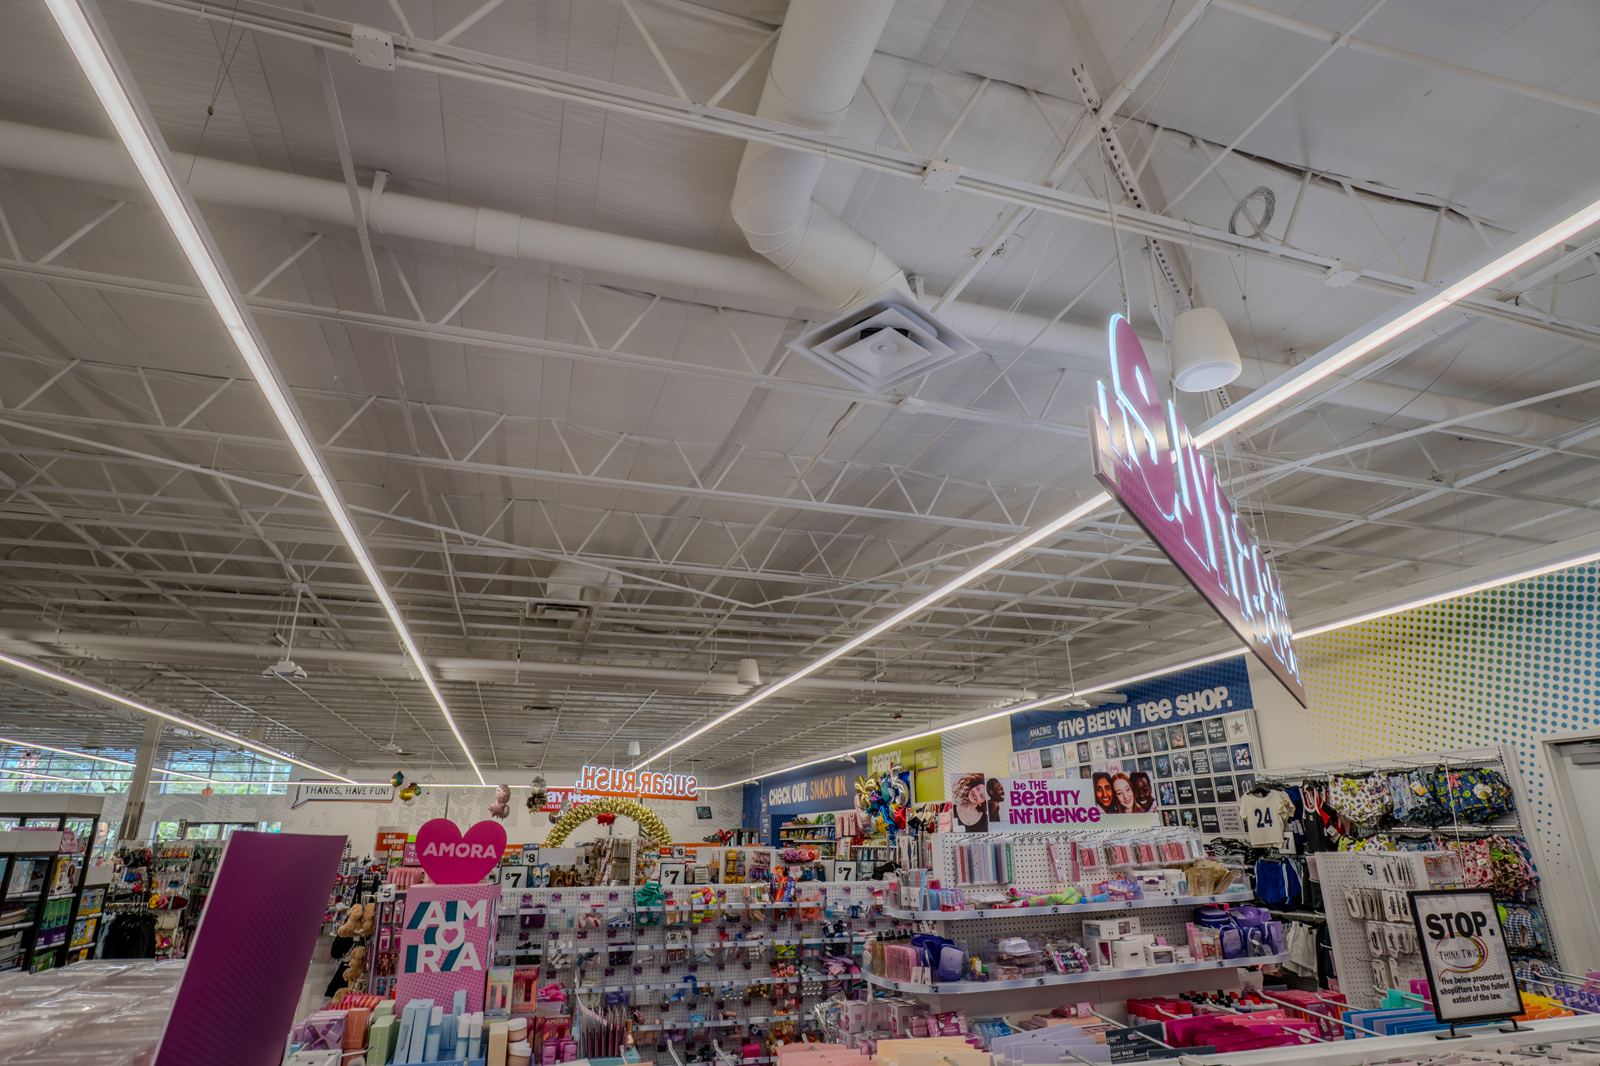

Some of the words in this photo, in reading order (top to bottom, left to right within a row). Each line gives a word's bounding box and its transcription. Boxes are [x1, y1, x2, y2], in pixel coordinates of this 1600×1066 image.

[1176, 686, 1233, 717] SHOP.
[305, 786, 342, 797] THANKS,
[344, 787, 368, 796] HAVE
[369, 787, 390, 796] FUN!
[810, 778, 833, 801] SNACK
[834, 775, 848, 798] ON.
[1013, 781, 1026, 791] be
[1028, 780, 1048, 790] THE
[1254, 807, 1273, 828] 24
[423, 841, 497, 860] AMORA
[525, 853, 536, 863] $8
[838, 866, 852, 881] $7
[1363, 864, 1374, 876] $5
[505, 872, 522, 888] $7
[664, 870, 680, 885] $7
[1425, 911, 1495, 940] STOP.
[1439, 950, 1460, 960] THINK
[1441, 977, 1453, 985] five
[1454, 975, 1471, 984] below
[1472, 973, 1505, 983] prosecutes
[1440, 985, 1473, 995] shoplifters
[1491, 982, 1510, 990] fullest
[1452, 995, 1472, 1004] extent
[1473, 994, 1479, 1002] of
[1480, 993, 1490, 1001] the
[1490, 992, 1503, 1000] law.
